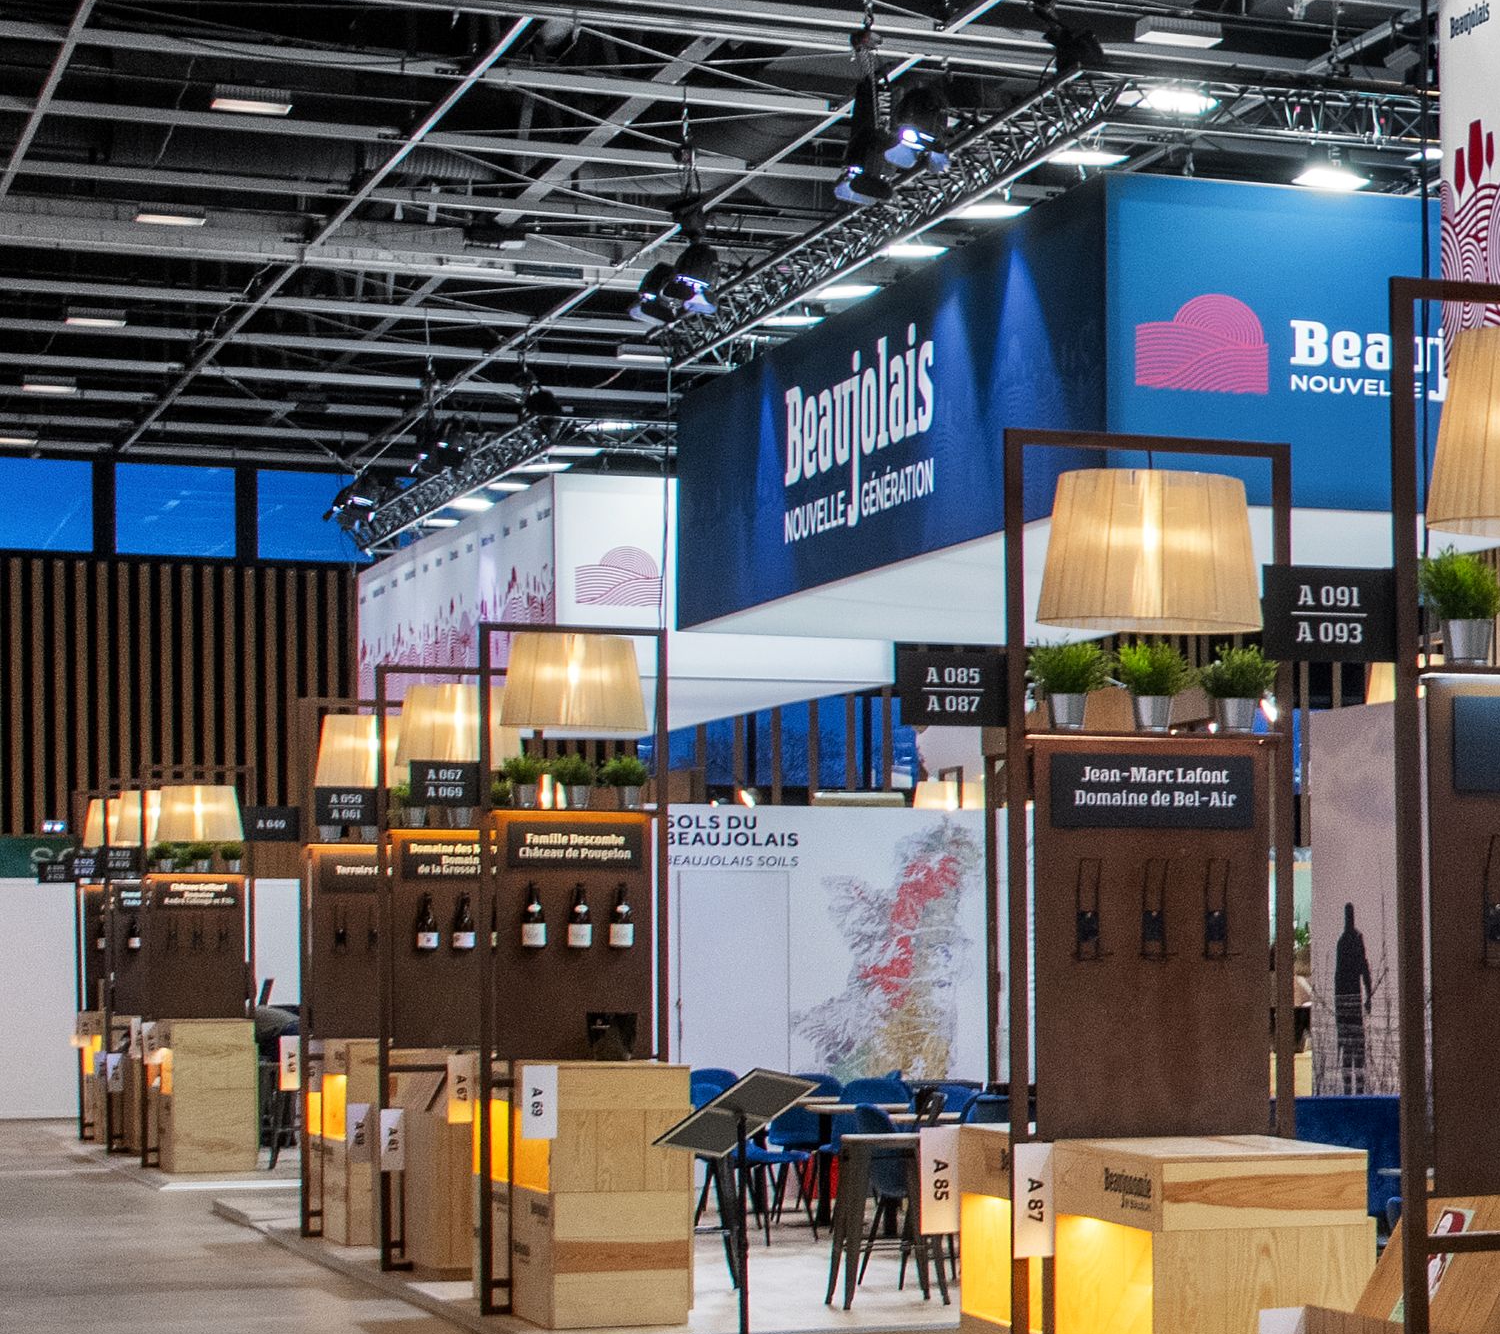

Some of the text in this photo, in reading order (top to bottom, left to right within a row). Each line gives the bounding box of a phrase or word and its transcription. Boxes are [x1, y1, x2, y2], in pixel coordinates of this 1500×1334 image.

[1450, 0, 1490, 38] Beaujolais
[1290, 375, 1422, 398] NOUVELE
[784, 323, 934, 528] Beaujolais
[784, 457, 935, 545] NOUVELLE GÉNÉRATION
[1298, 585, 1360, 607] A 091
[1296, 621, 1362, 644] A 093
[926, 667, 980, 684] A 085
[927, 695, 980, 712] A 087
[427, 769, 436, 781] A
[1081, 766, 1229, 784] Jean-Marc Lafont
[427, 786, 436, 797] A
[1074, 789, 1237, 808] Domaine de Bel-Air
[667, 815, 757, 830] SOLS DU
[525, 833, 625, 846] Famille Descombe
[667, 832, 799, 847] BEAUJOLAIS
[519, 846, 564, 859] Château
[566, 848, 579, 859] de
[757, 855, 799, 867] SOILS
[456, 1075, 467, 1085] A
[531, 1087, 544, 1117] A 69
[933, 1159, 949, 1201] A 85
[1027, 1178, 1044, 1223] A 87
